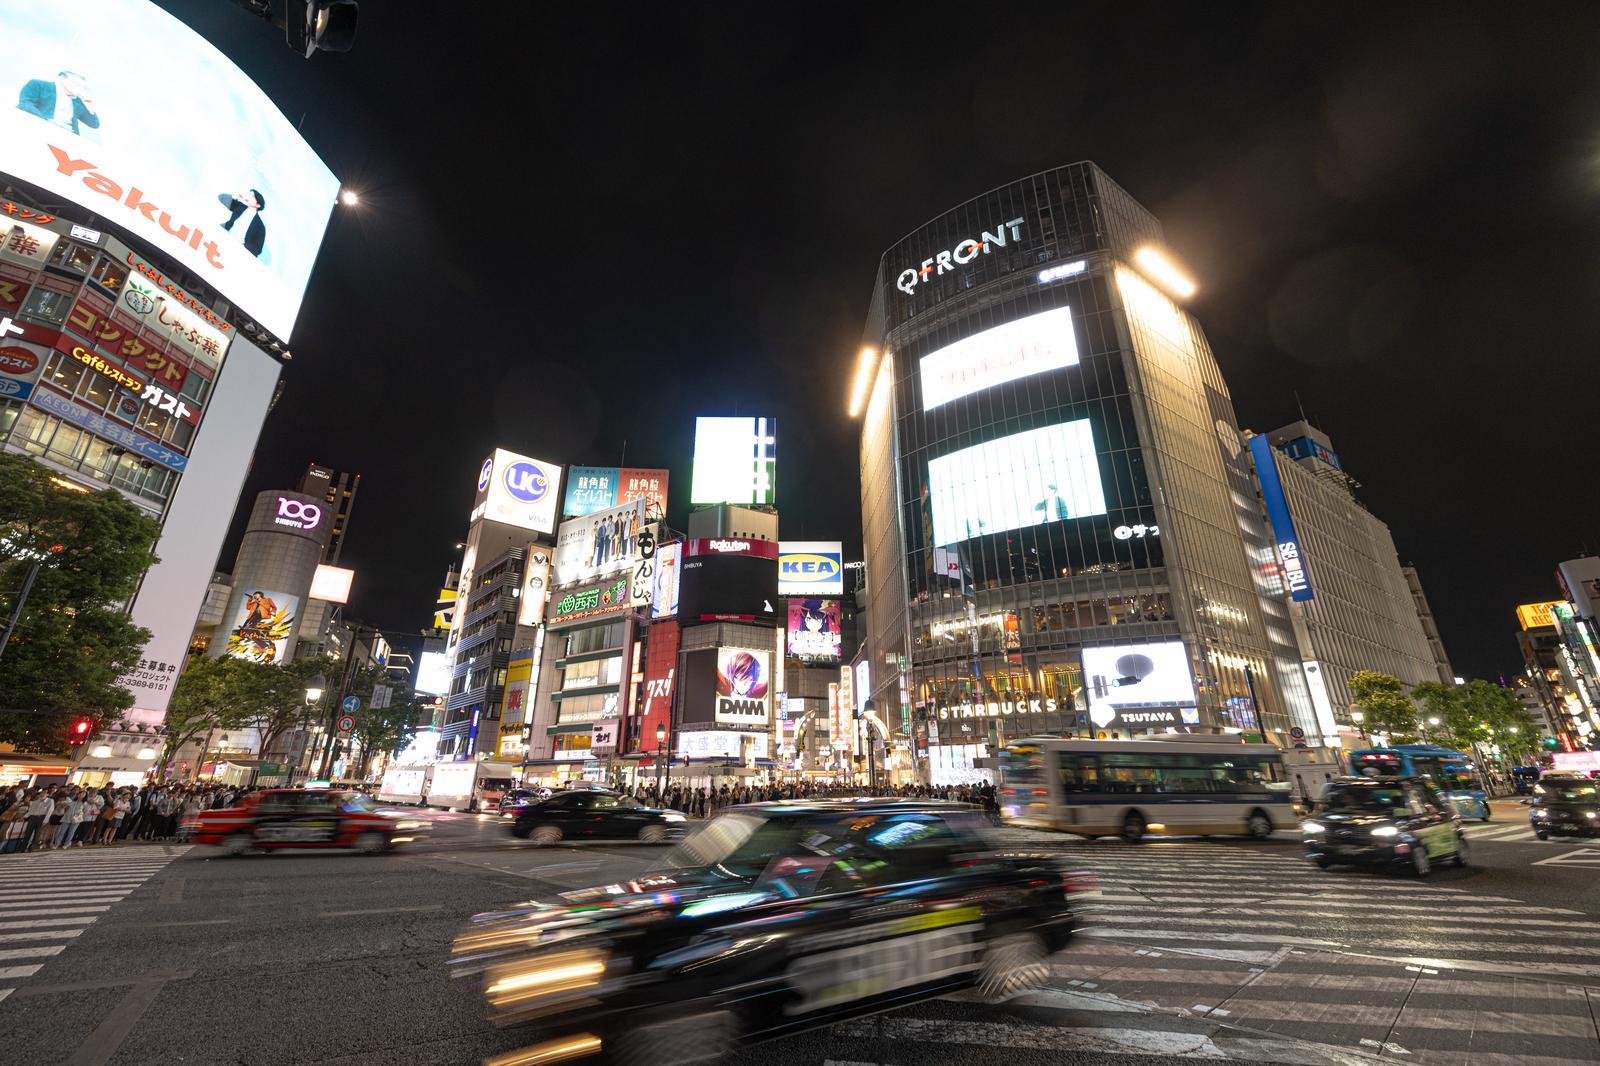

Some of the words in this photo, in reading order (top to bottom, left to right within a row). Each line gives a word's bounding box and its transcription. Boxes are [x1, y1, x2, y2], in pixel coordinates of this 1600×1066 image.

[47, 143, 225, 270] Yakult
[896, 216, 1025, 296] QFRONT
[127, 252, 232, 331] しゃぶしゃぶバイキング
[69, 301, 185, 382] コンタクト
[158, 306, 221, 357] しゃぶ葉
[140, 384, 191, 419] ガスト
[87, 413, 185, 467] 英会話イーオン
[507, 467, 547, 496] UC
[573, 489, 612, 502] ダイレクト
[275, 517, 303, 529] SHIBUYA
[278, 496, 321, 529] 109
[709, 540, 751, 552] Rakuten
[634, 526, 656, 603] もんじゃ
[575, 593, 599, 611] 西村
[644, 668, 675, 716] クスリ
[718, 699, 765, 716] DMM
[940, 698, 1057, 720] STARBUCKS
[1120, 712, 1175, 723] TSUTAYA
